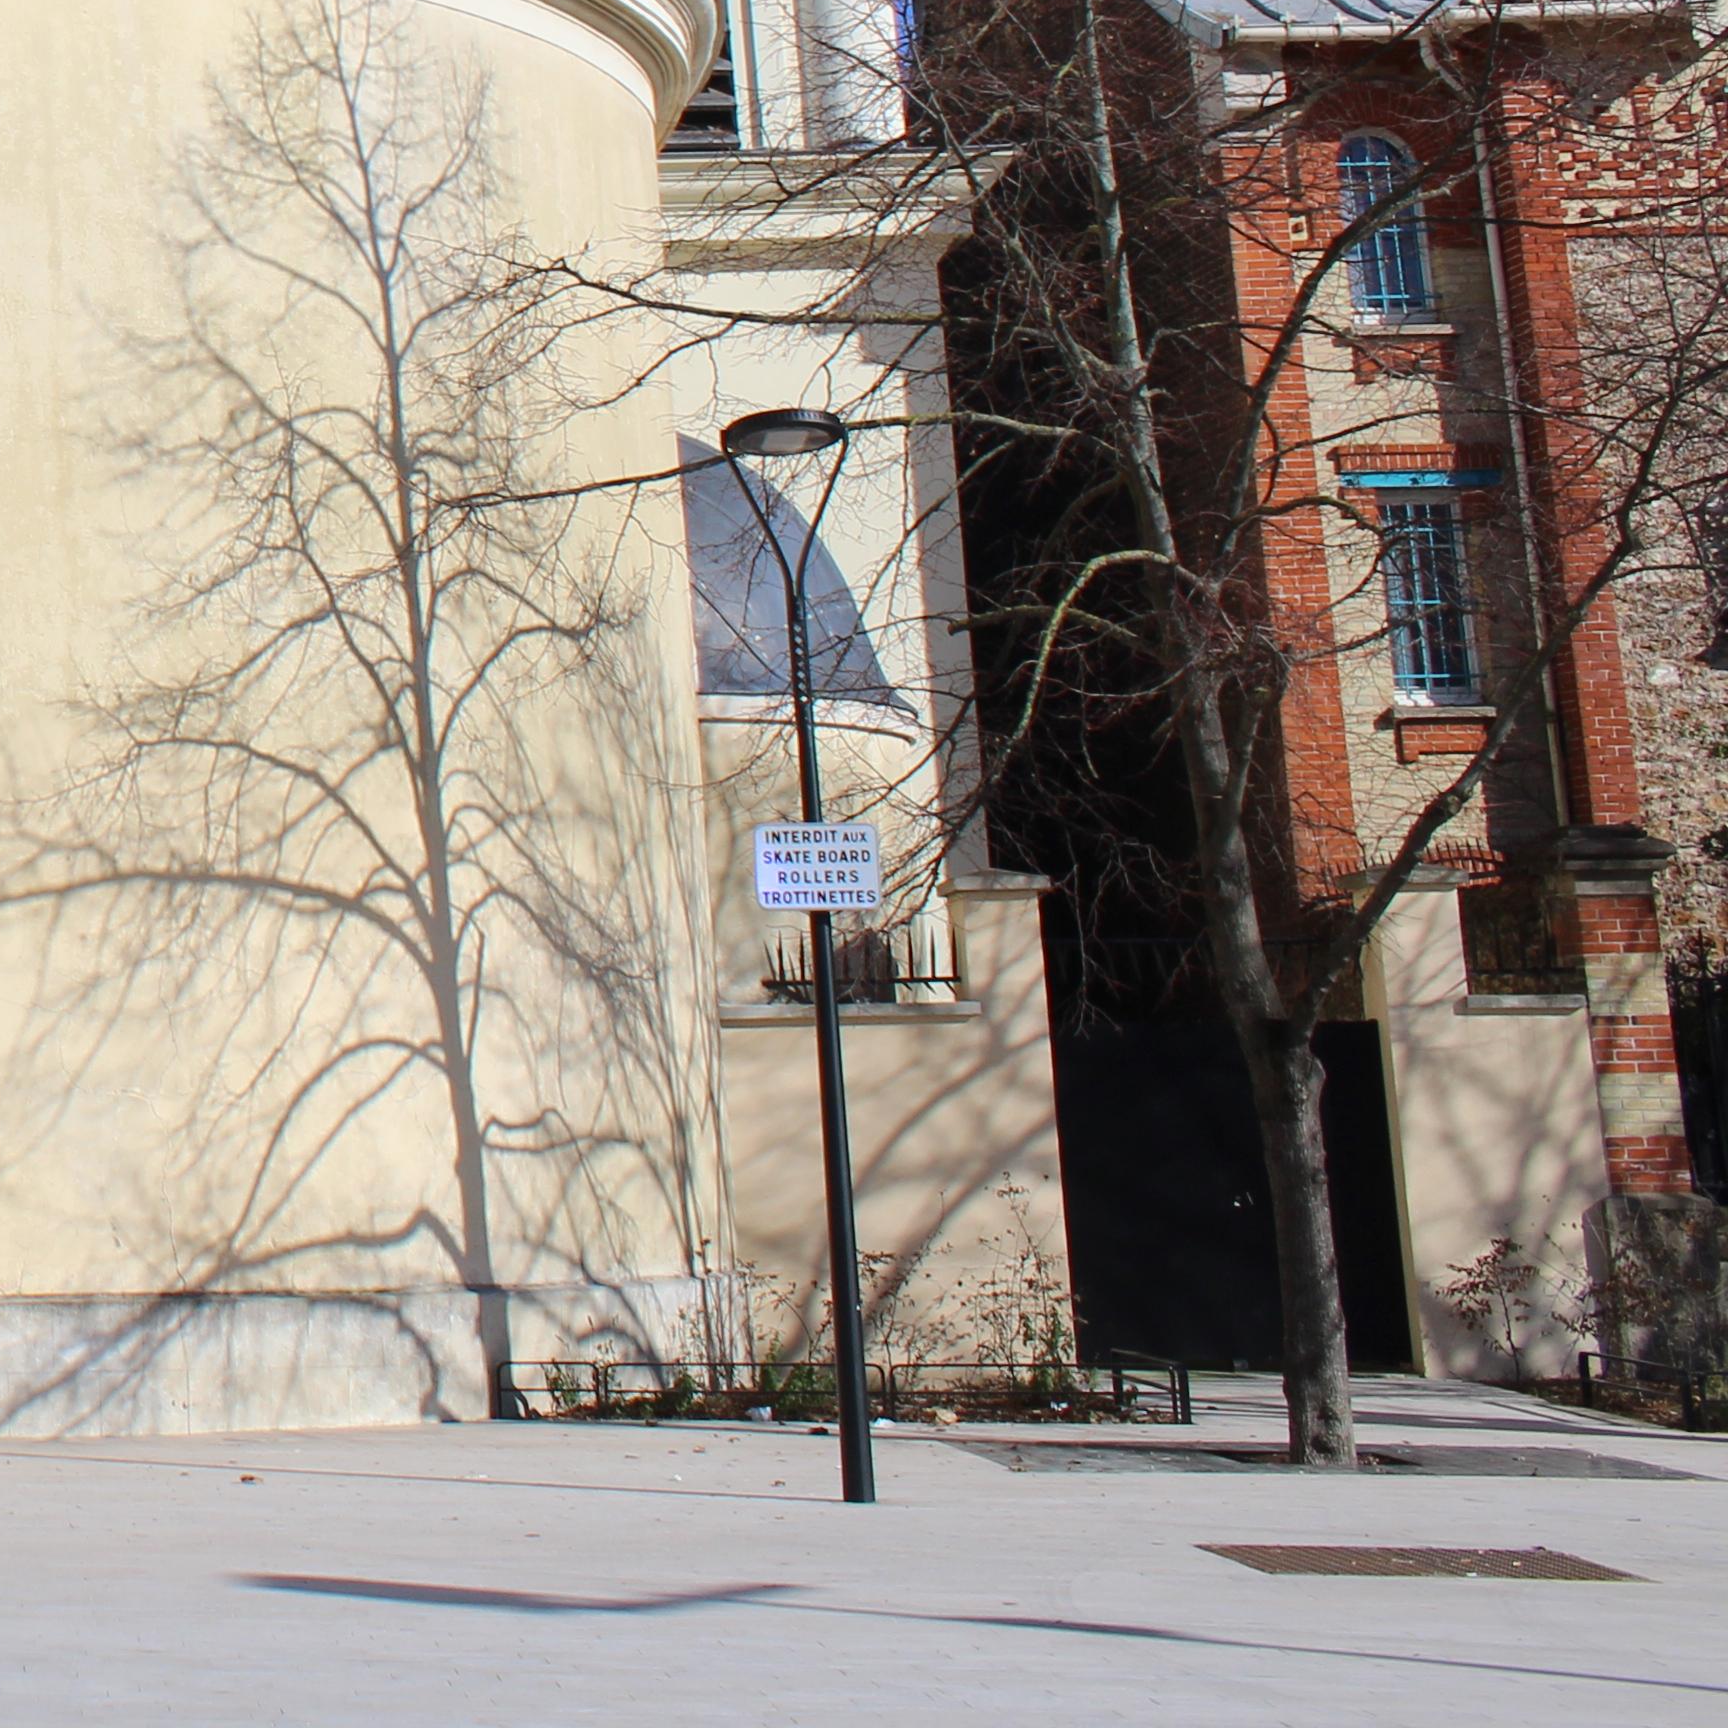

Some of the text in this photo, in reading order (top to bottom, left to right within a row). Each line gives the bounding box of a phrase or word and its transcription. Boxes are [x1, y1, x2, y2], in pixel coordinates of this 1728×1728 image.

[765, 830, 867, 844] INTERDIT AUX
[763, 850, 871, 864] SKATE BOARD
[778, 870, 860, 884] ROLLERS
[762, 890, 876, 904] TROTTINETTES
